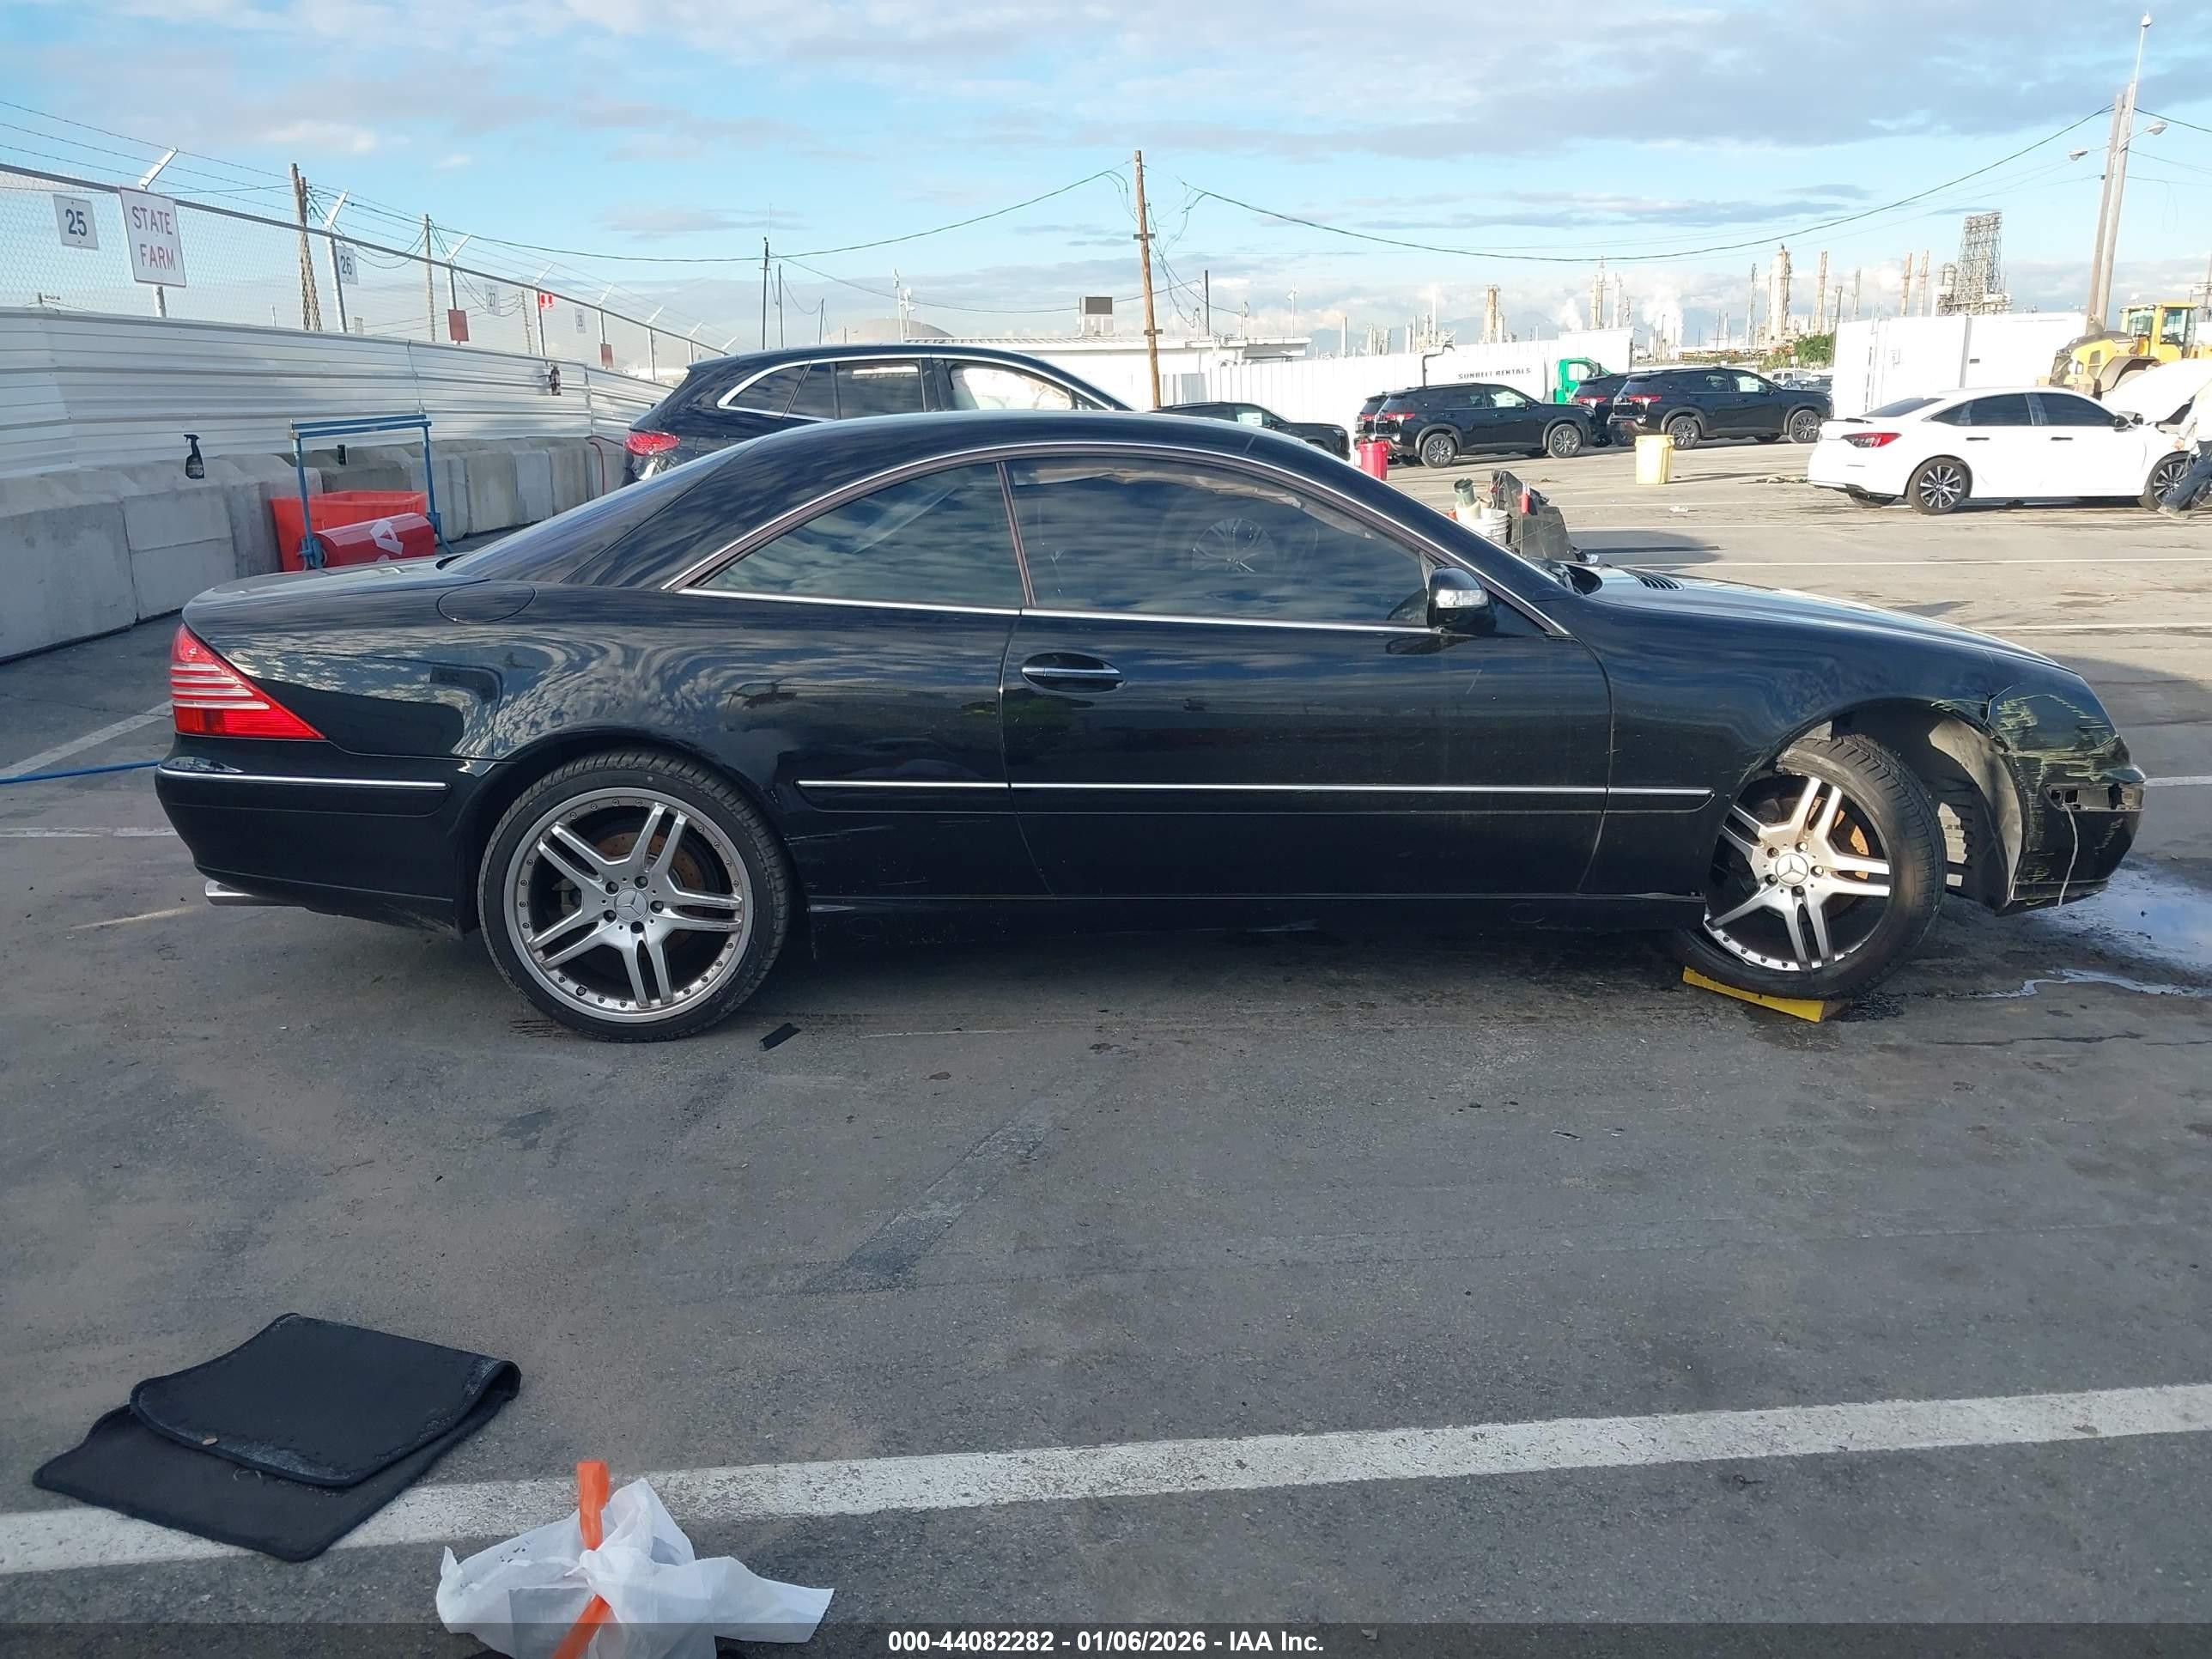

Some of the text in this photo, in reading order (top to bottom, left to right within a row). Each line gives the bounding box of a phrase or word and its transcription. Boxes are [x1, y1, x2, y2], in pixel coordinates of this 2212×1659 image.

[65, 209, 88, 236] 25
[132, 206, 173, 235] STATE
[140, 243, 176, 270] FARM
[340, 255, 352, 275] 26
